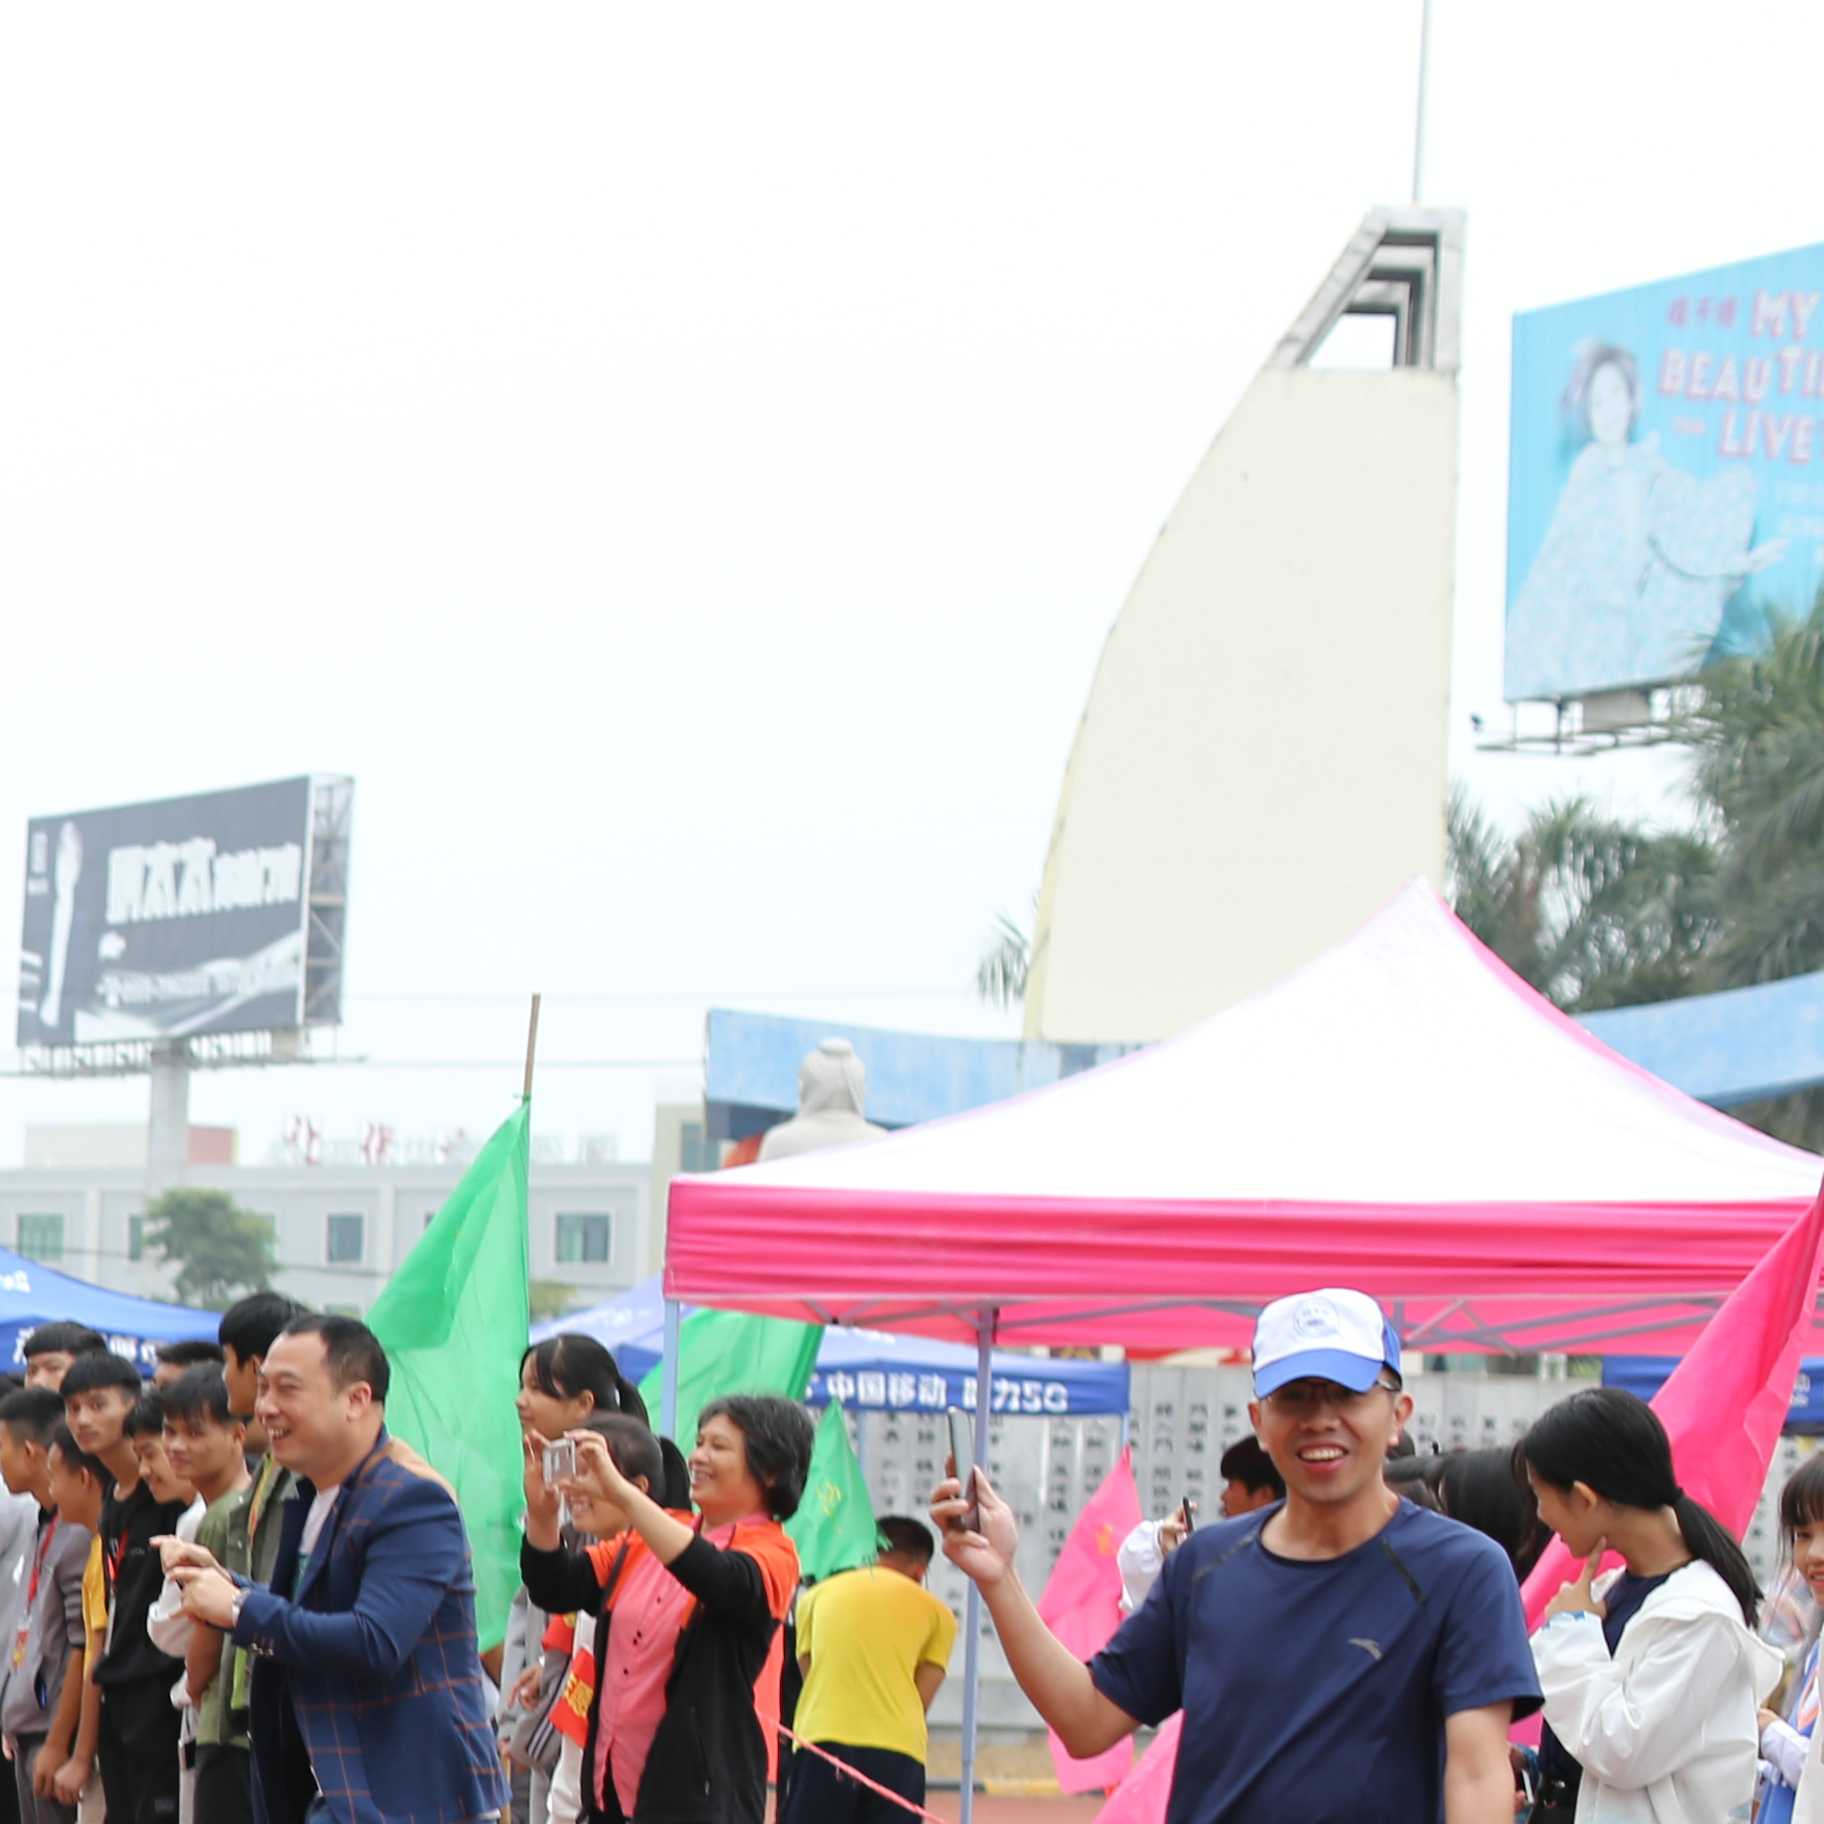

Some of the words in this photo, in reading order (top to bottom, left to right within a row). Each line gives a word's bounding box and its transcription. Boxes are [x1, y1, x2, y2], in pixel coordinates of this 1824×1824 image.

[1751, 288, 1820, 340] MY
[1658, 345, 1824, 404] BEAUTI
[1718, 410, 1824, 465] LIVE
[826, 1370, 947, 1410] 中国移动
